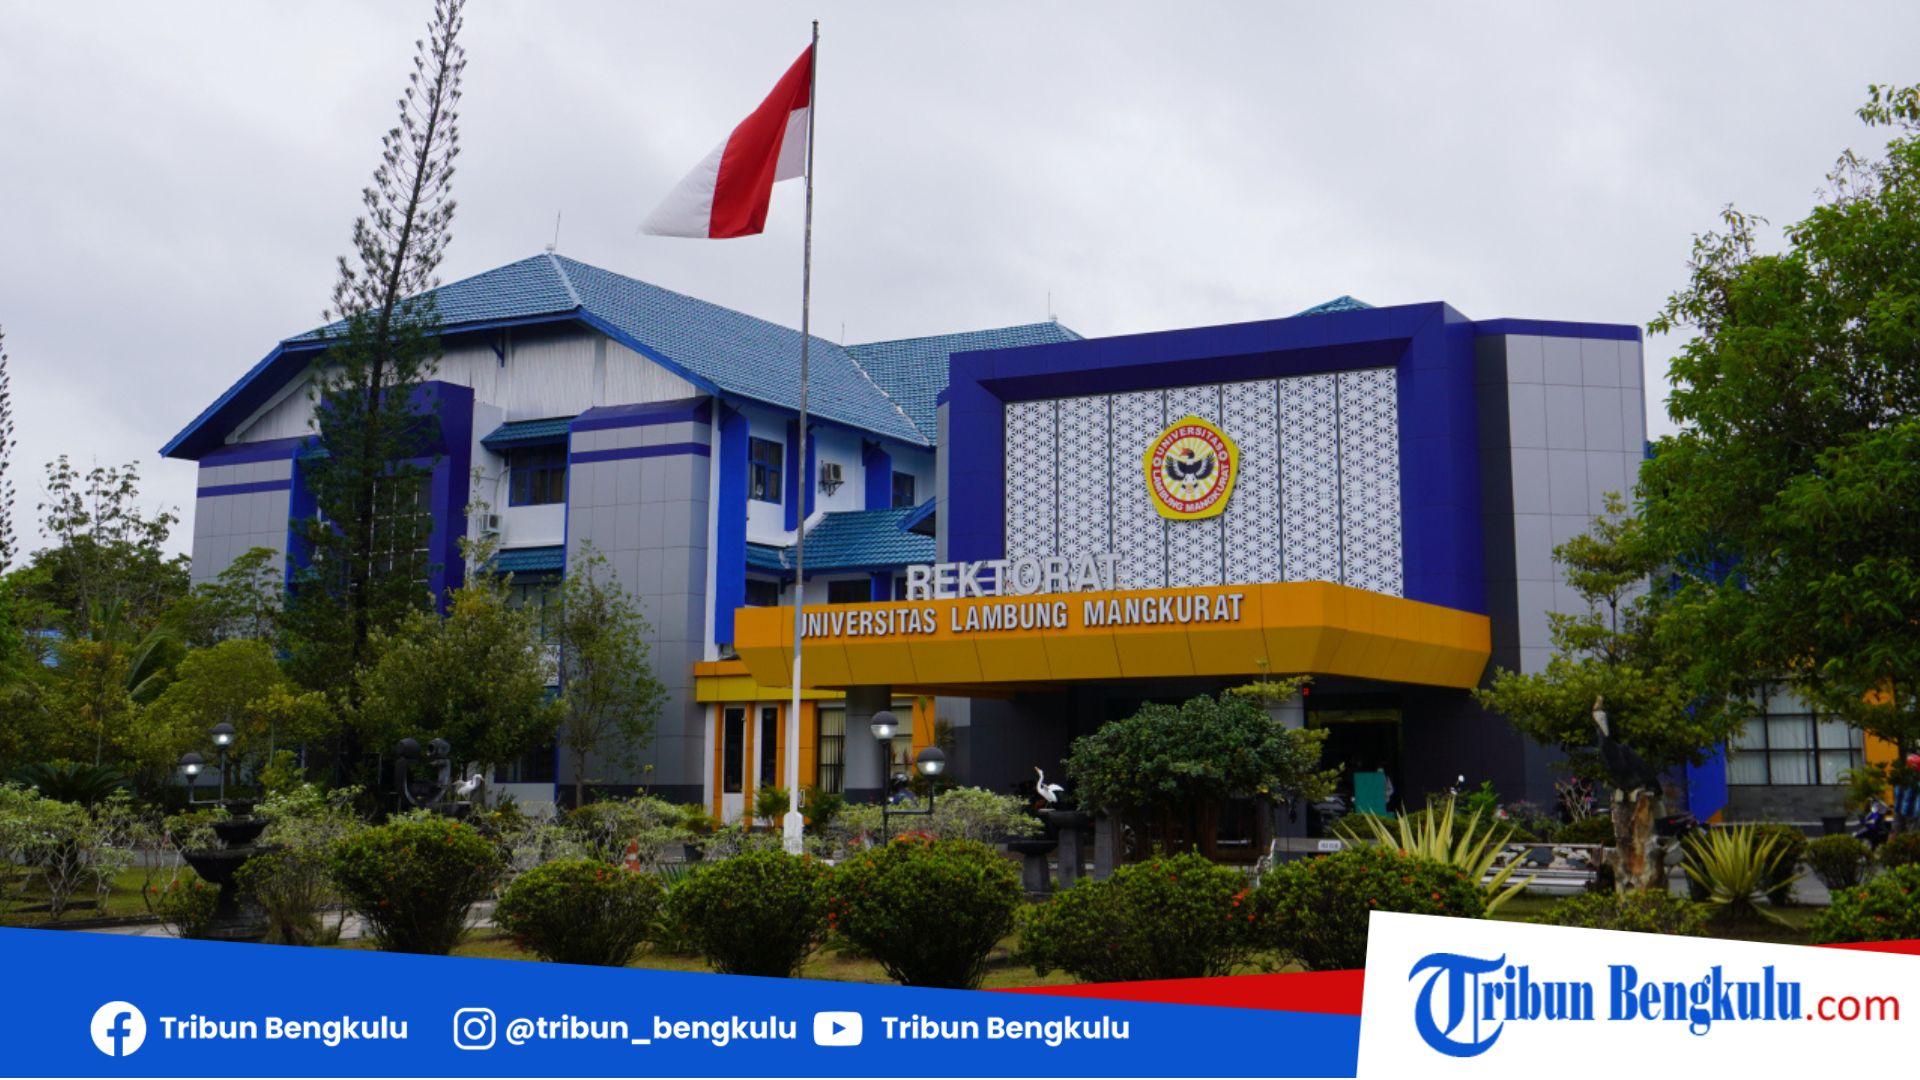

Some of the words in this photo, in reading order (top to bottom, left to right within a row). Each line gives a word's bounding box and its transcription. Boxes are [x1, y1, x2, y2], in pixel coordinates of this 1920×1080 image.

[1157, 426, 1224, 456] UNIVERSITAS
[906, 553, 1123, 601] REKTORAT
[951, 601, 1069, 632] LAMBUNG
[1083, 593, 1245, 627] MANGKURAT
